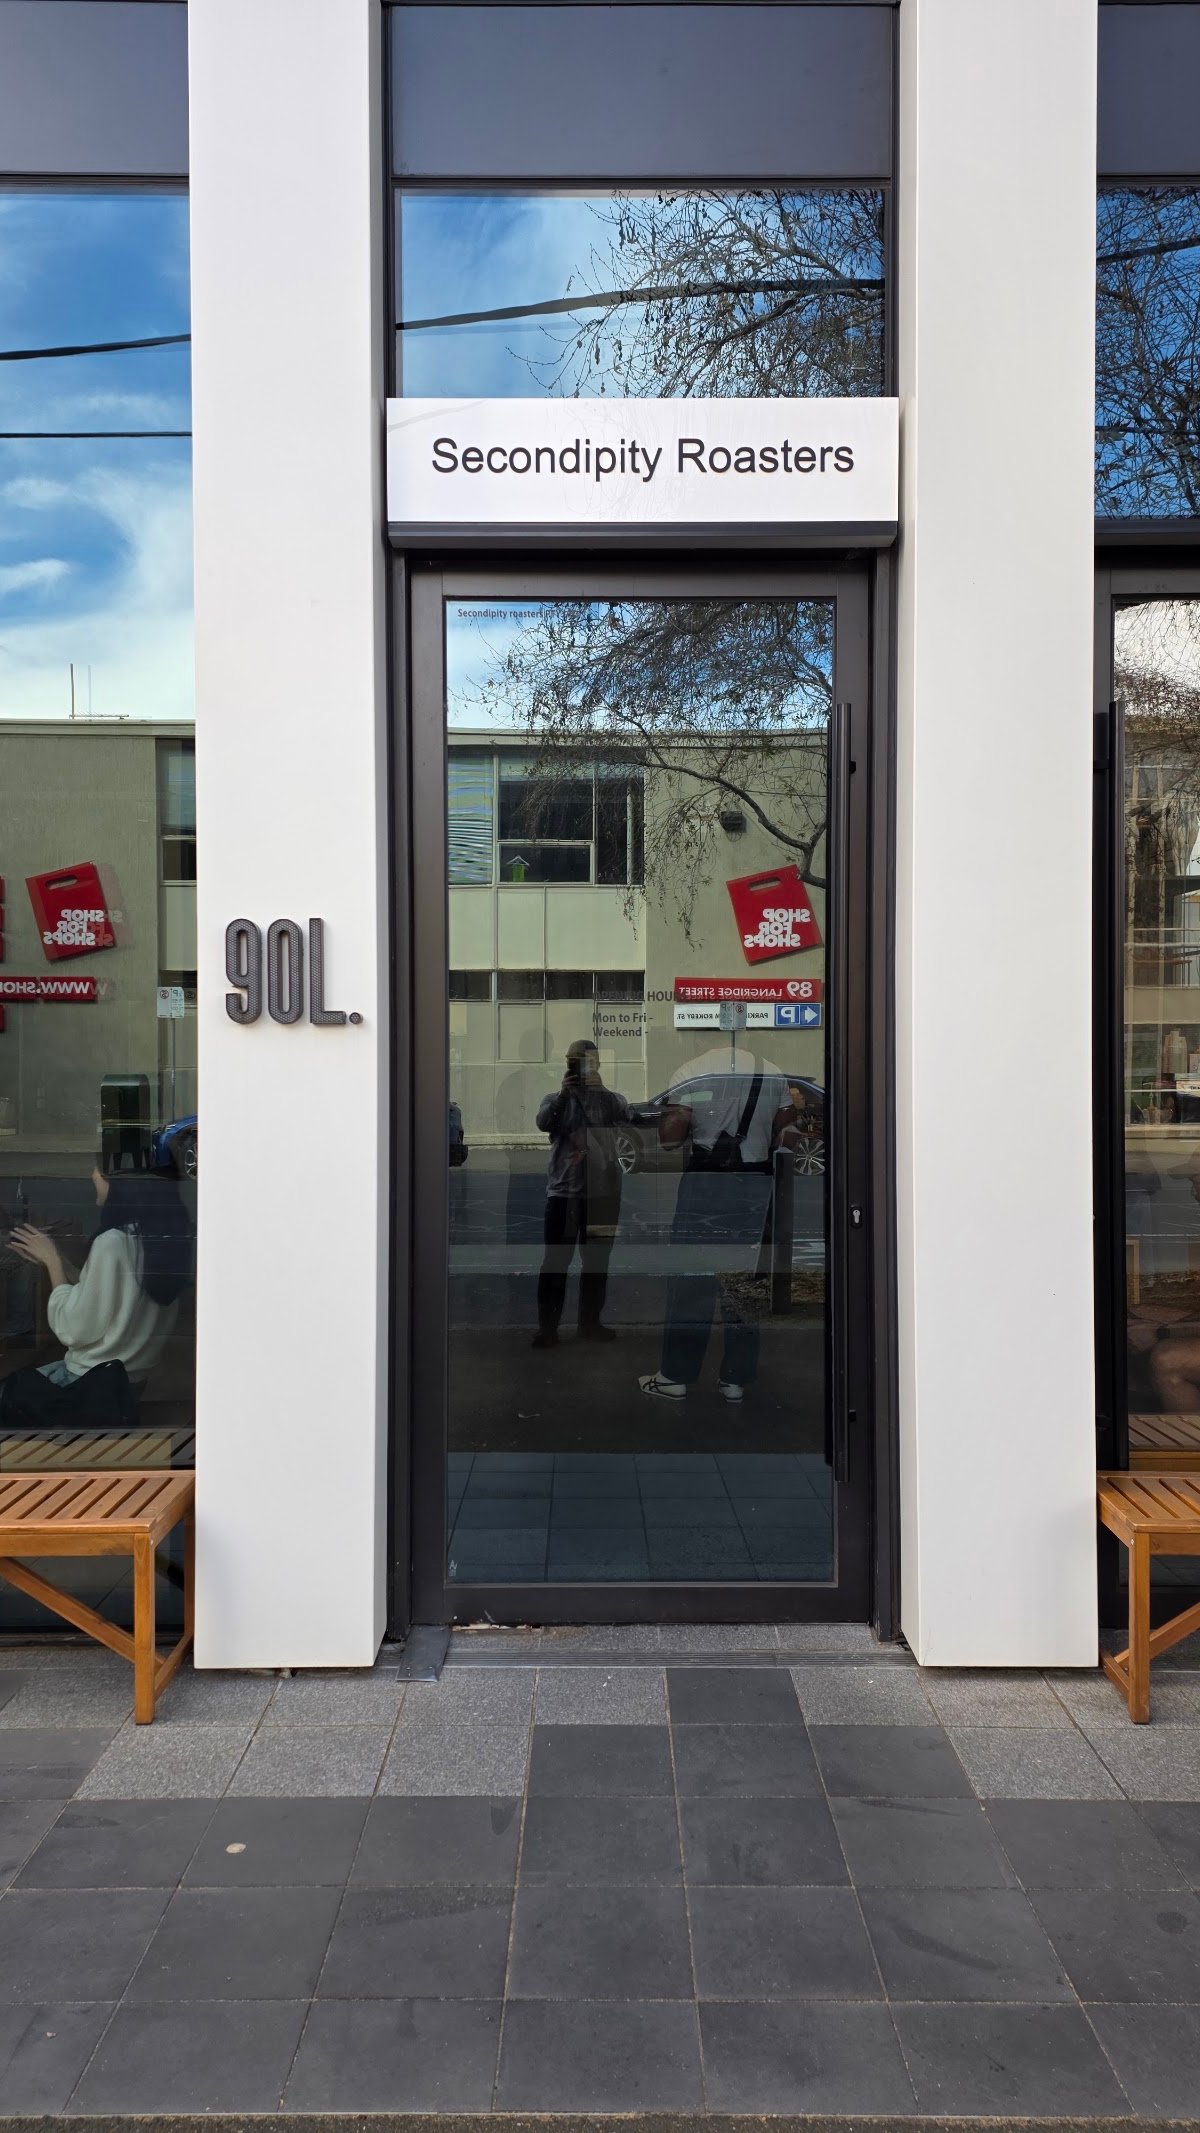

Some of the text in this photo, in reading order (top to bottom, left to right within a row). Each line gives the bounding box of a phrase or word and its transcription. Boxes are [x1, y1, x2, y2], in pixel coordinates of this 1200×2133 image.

[432, 437, 855, 482] Secondipity Roasters
[457, 608, 507, 619] Secondipity
[509, 610, 543, 619] roasters
[592, 1012, 616, 1023] Mon
[621, 1013, 630, 1023] to
[632, 1012, 647, 1023] Fri
[592, 1026, 642, 1037] Weekend
